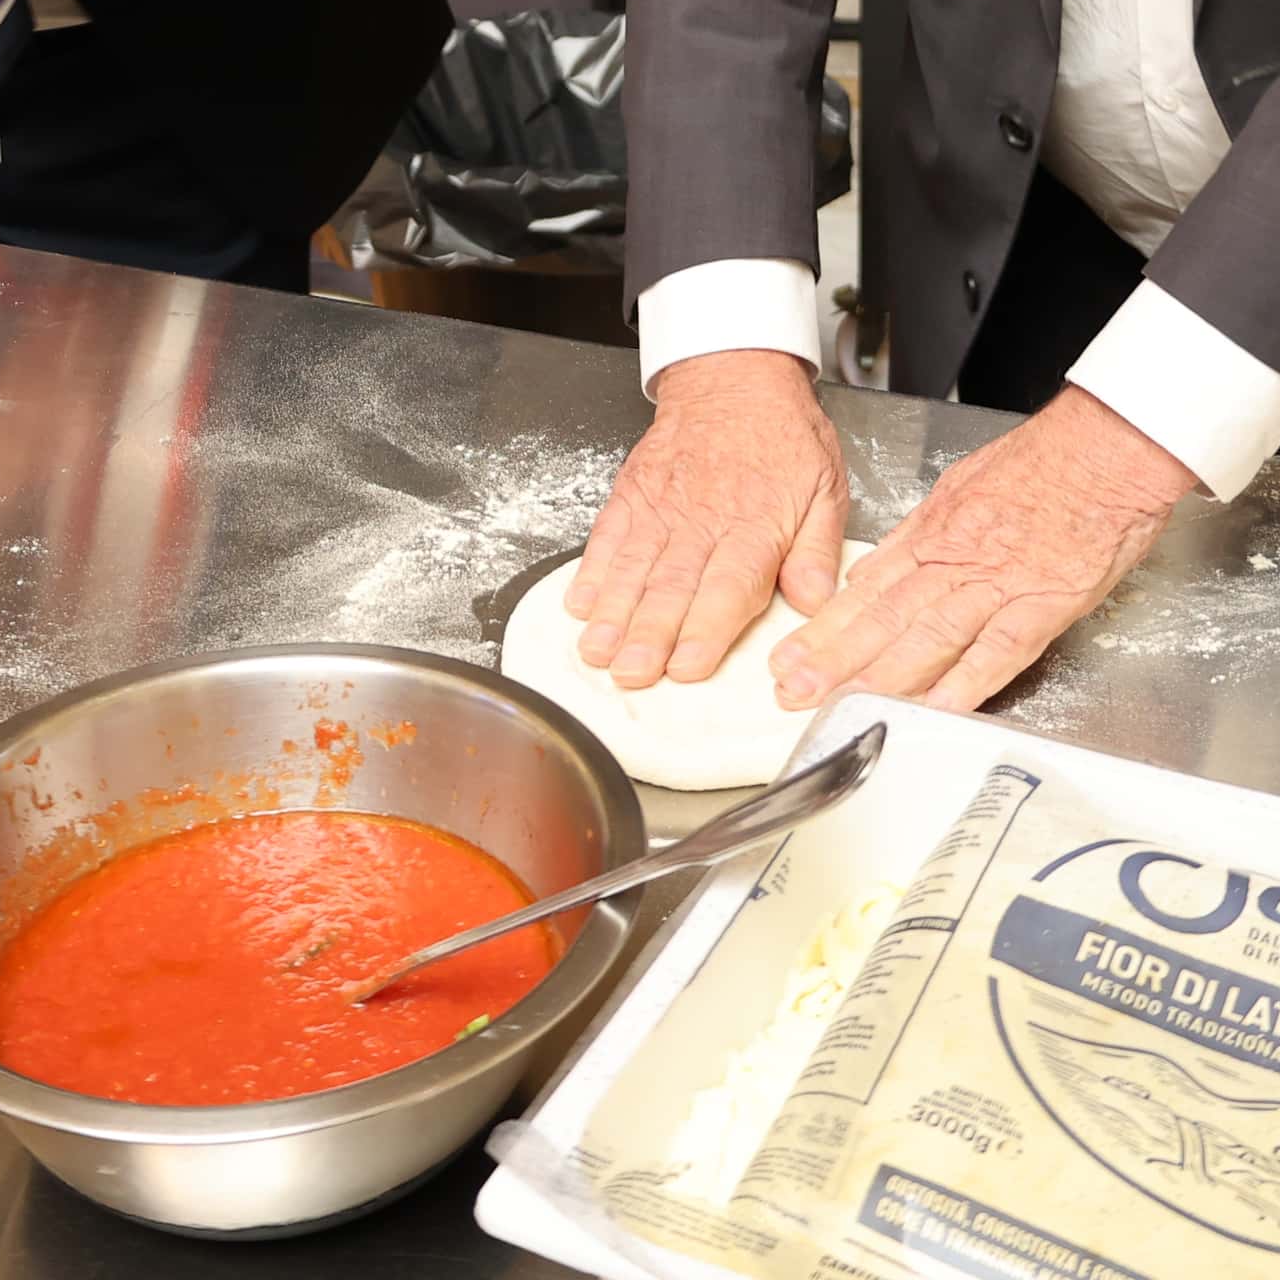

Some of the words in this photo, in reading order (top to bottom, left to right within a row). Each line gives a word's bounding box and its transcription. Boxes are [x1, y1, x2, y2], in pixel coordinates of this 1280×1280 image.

[1074, 930, 1169, 994] FIOR
[1172, 968, 1218, 1012] DI
[1242, 944, 1264, 962] DI
[1079, 971, 1163, 1017] METODO
